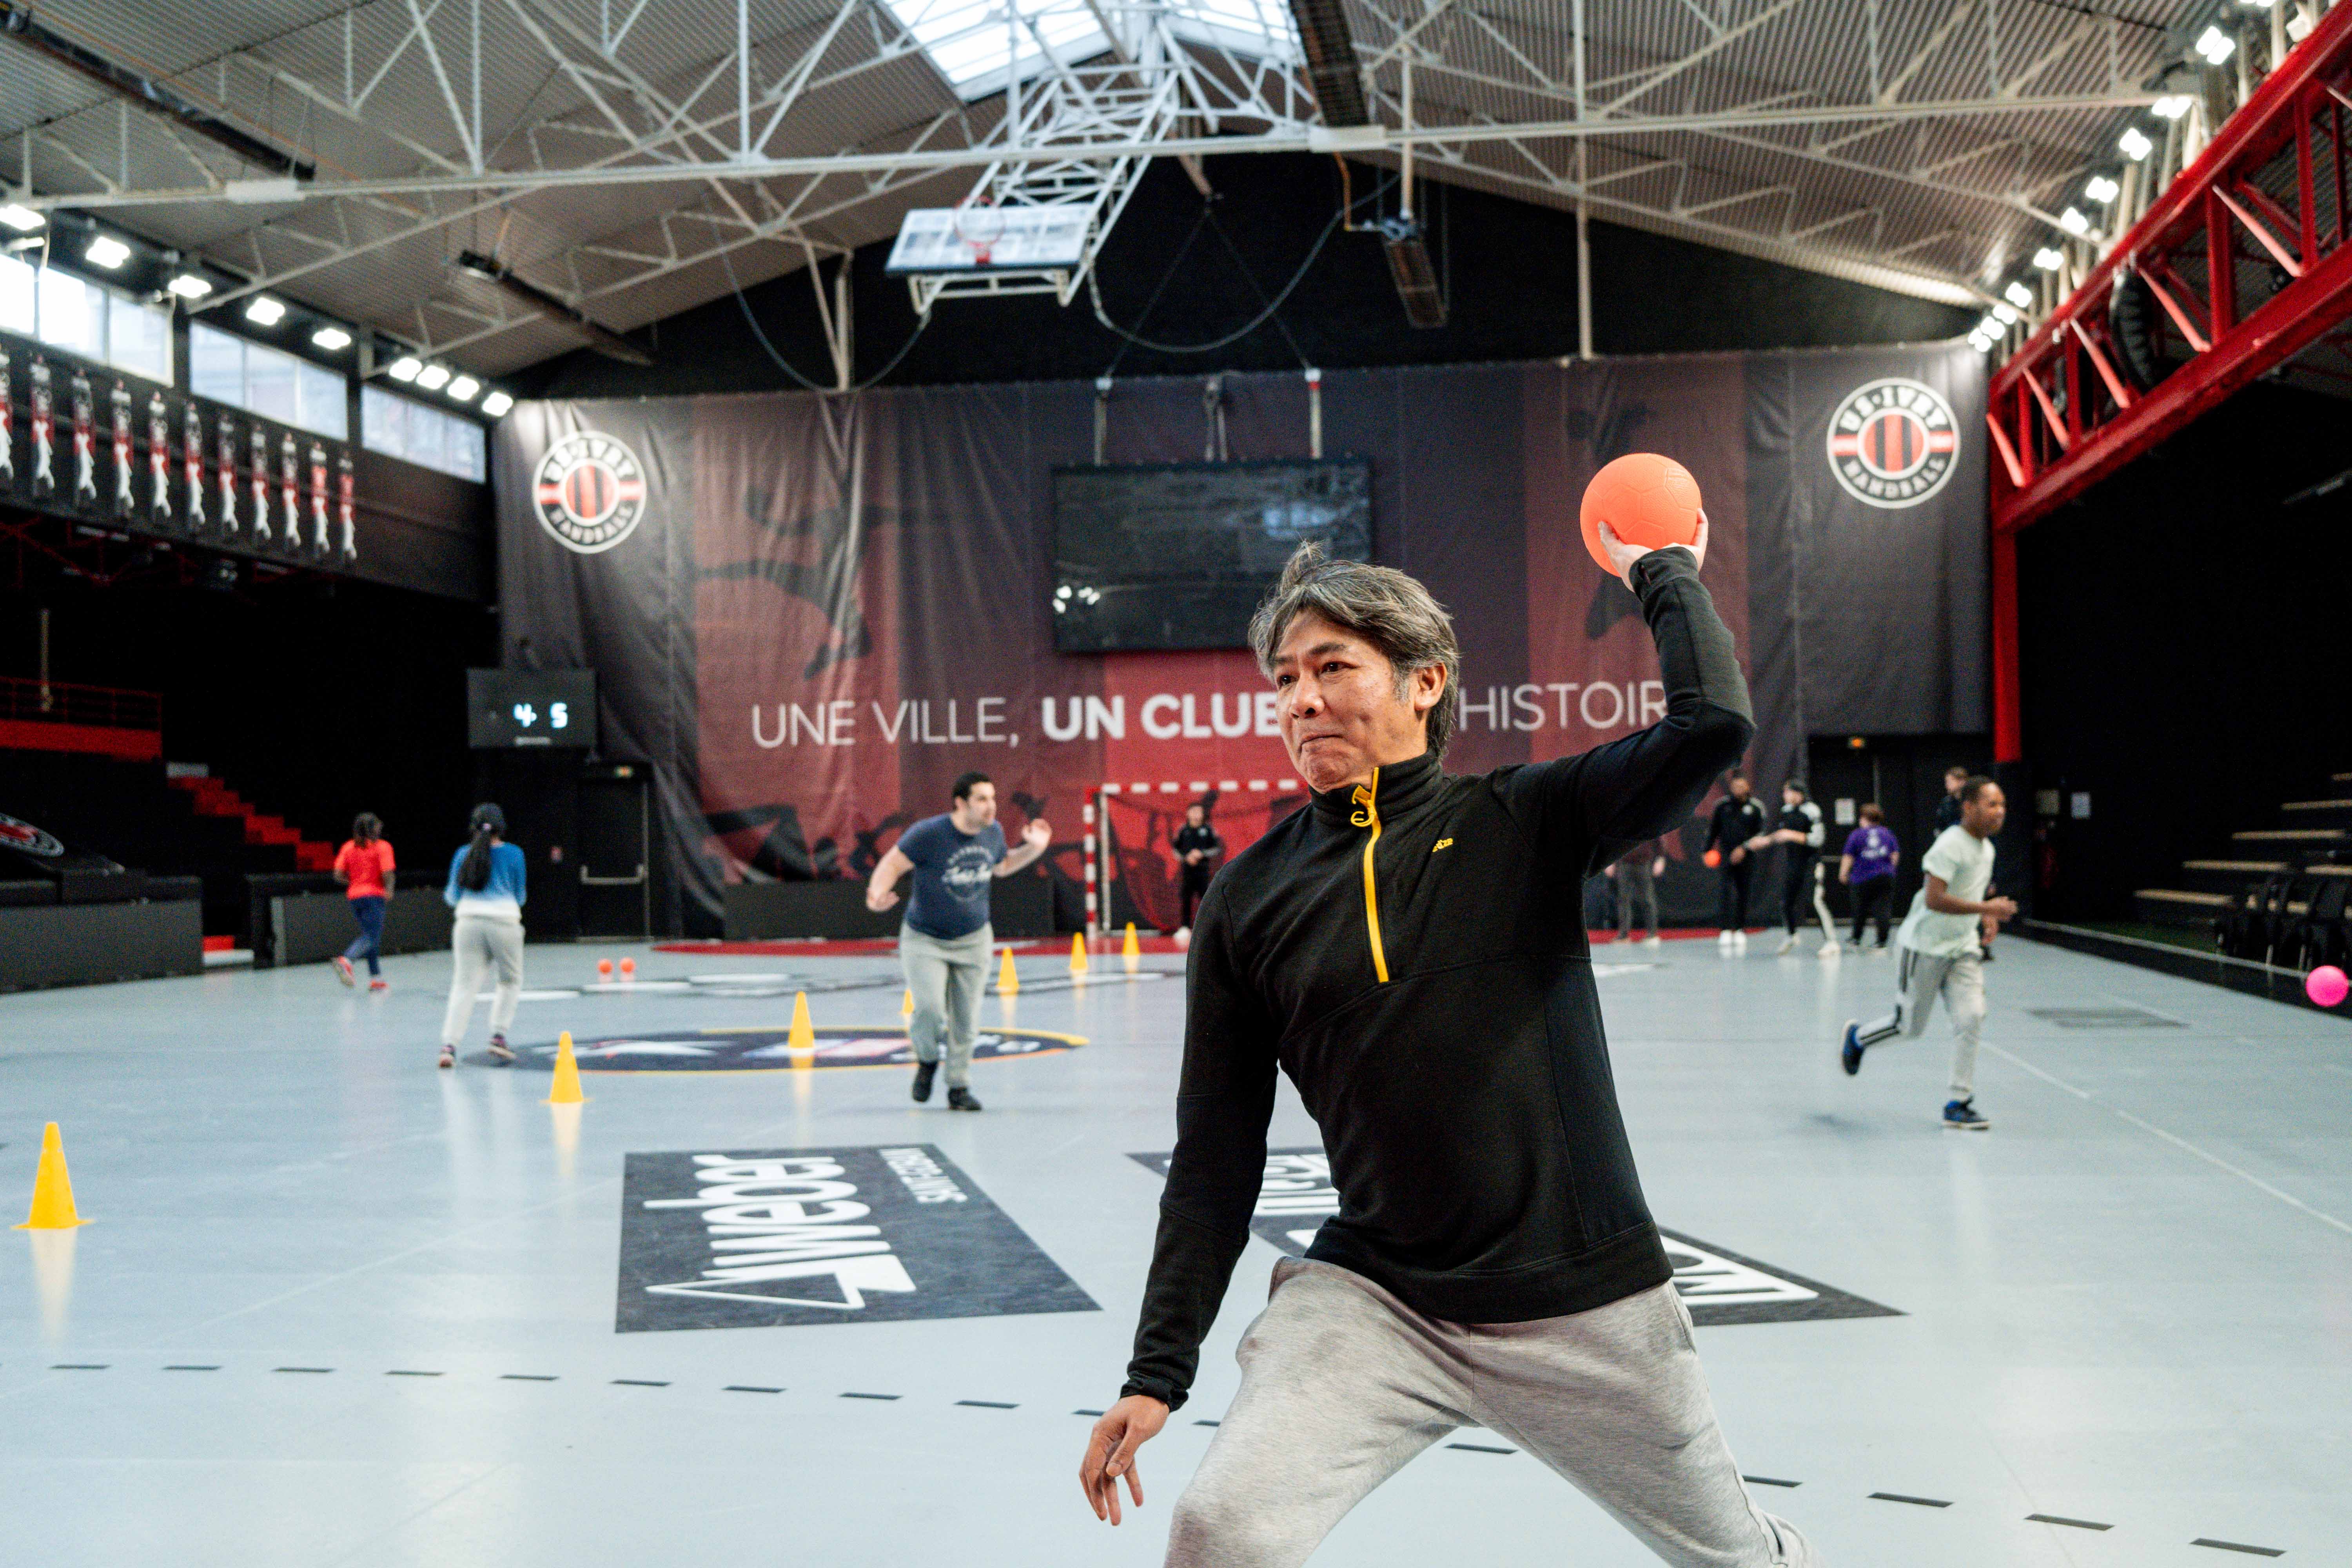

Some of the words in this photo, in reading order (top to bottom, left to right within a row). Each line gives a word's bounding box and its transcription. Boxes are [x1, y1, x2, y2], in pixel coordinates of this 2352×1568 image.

[751, 700, 856, 748] UNE
[872, 697, 1018, 748] VILLE,
[1042, 695, 1125, 742] UN
[1458, 680, 1668, 731] HISTOIR
[644, 1155, 891, 1266] weber
